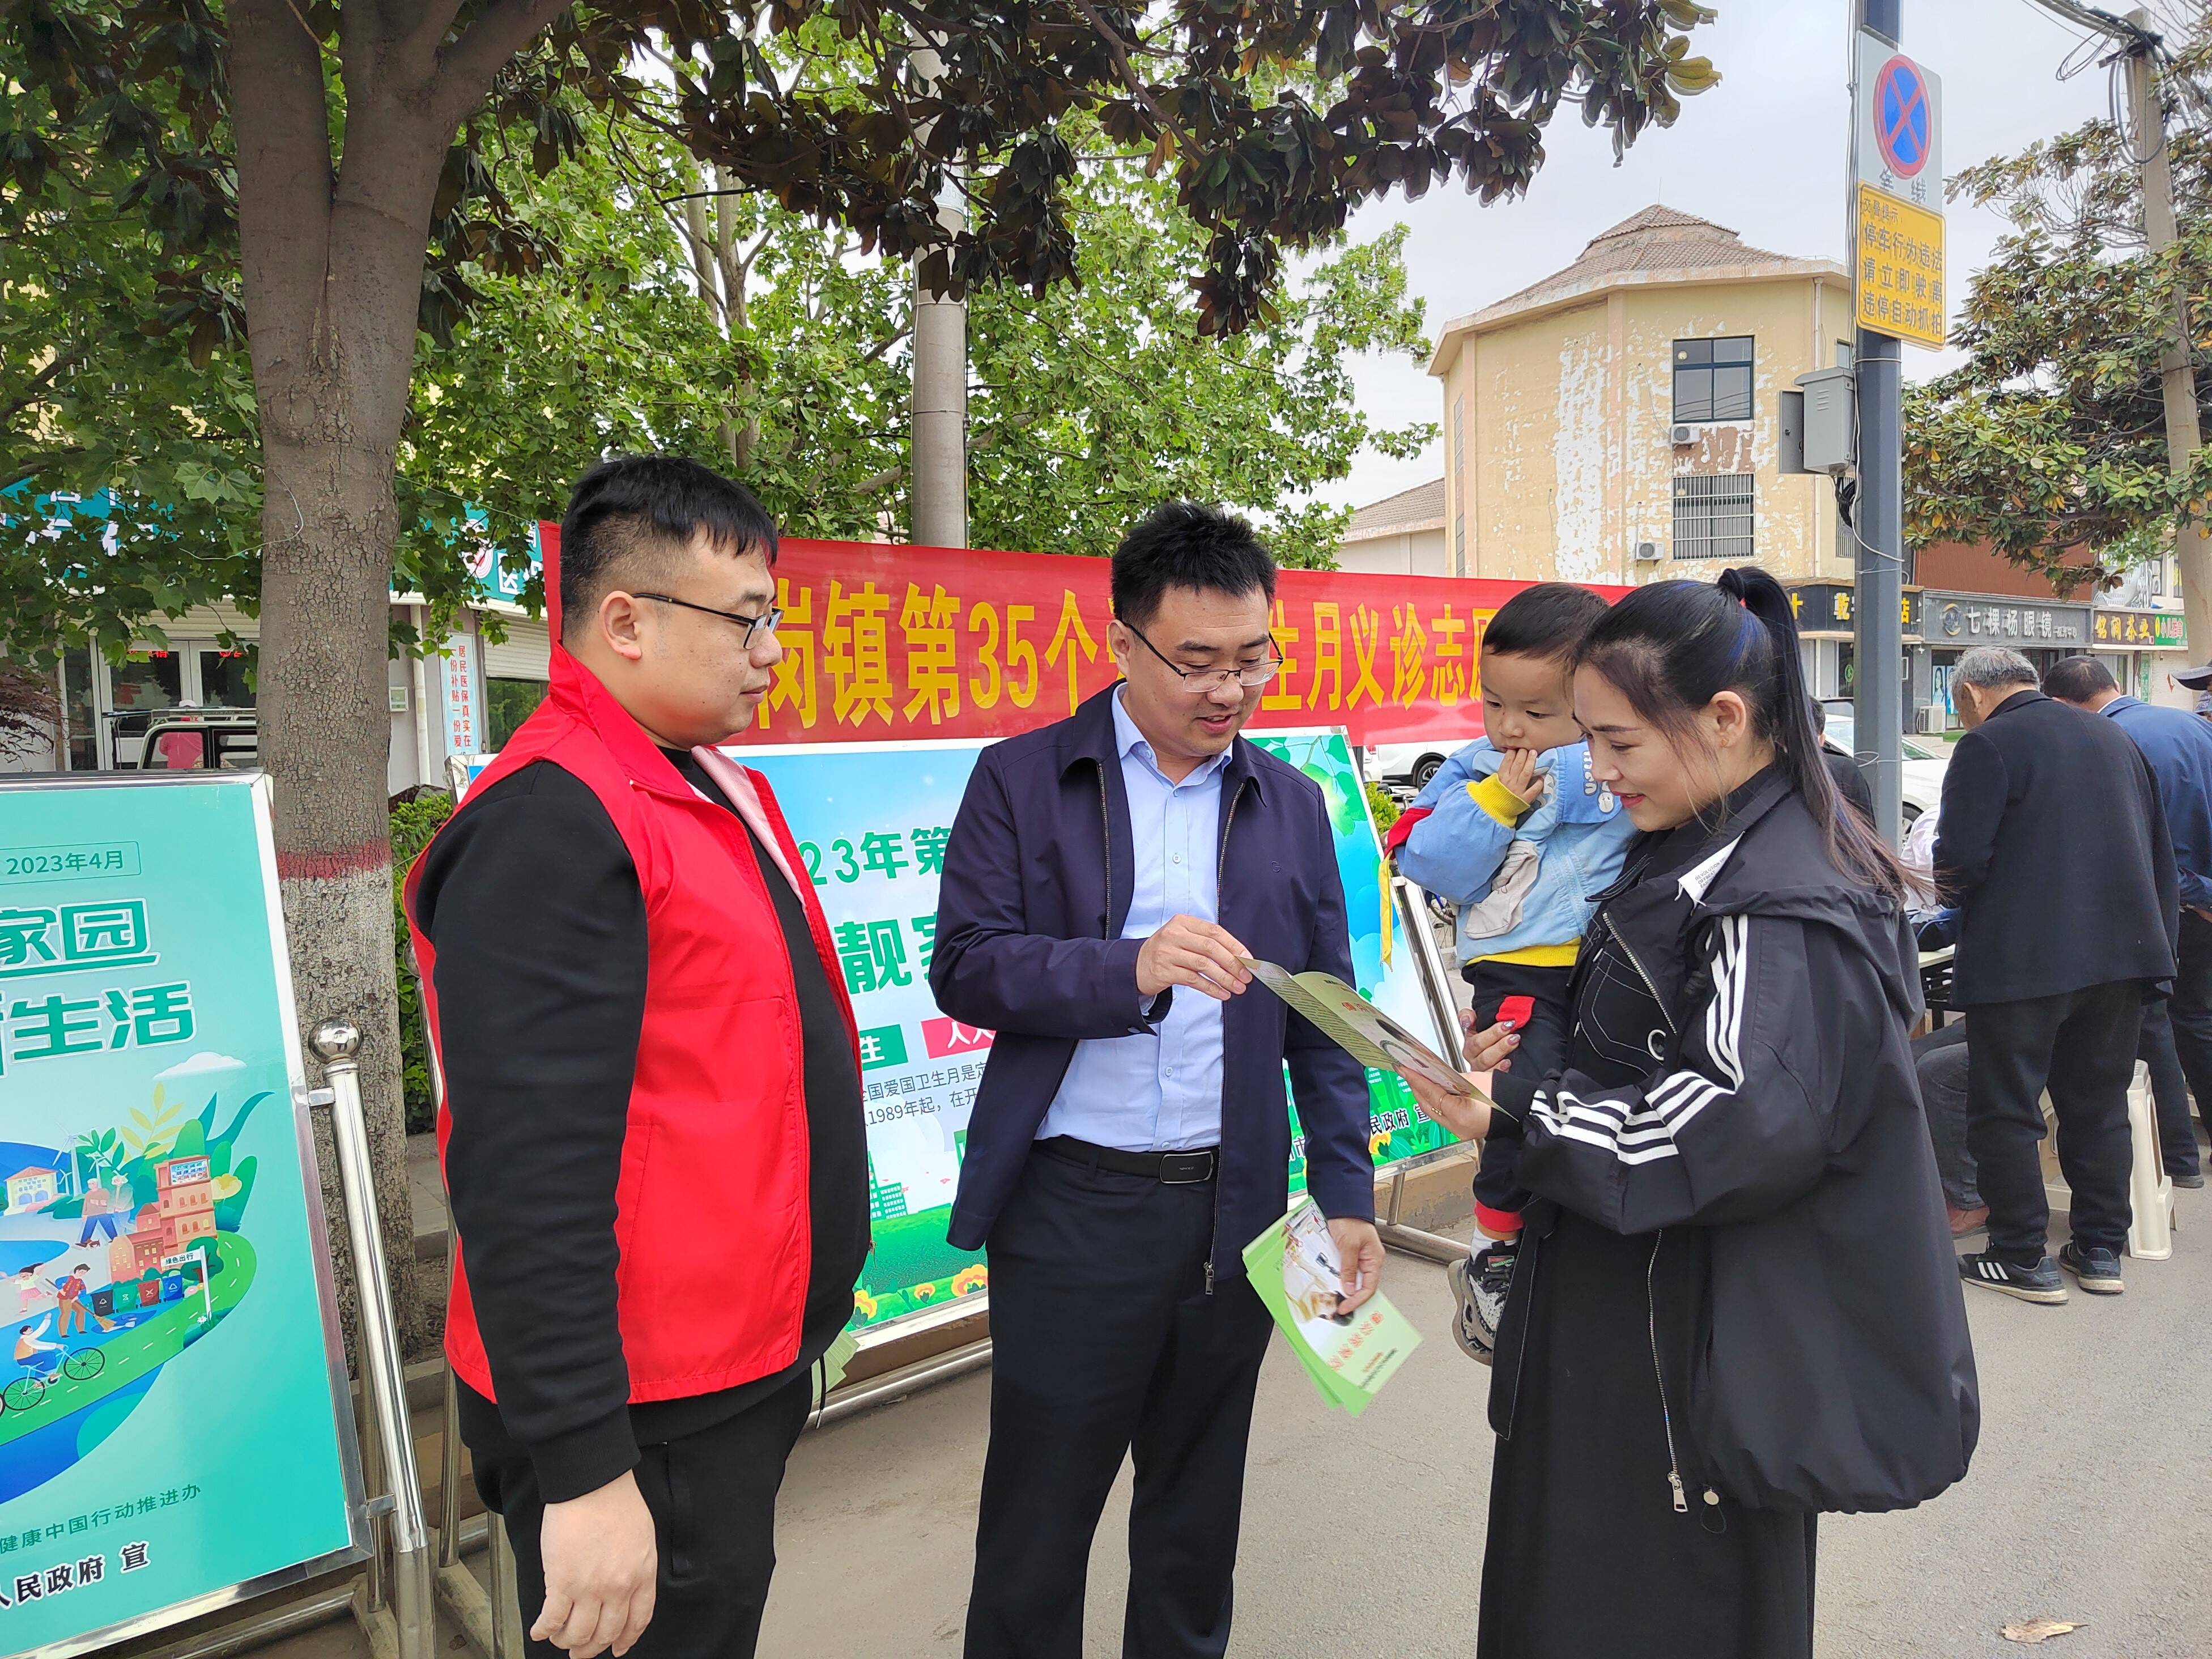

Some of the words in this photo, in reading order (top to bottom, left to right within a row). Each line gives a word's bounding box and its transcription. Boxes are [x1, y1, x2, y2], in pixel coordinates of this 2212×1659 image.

[1864, 221, 1942, 272] 停车行为违法
[1863, 256, 1942, 305] 请立即驶离
[1863, 290, 1942, 335] 违停自动抓拍
[1967, 606, 2052, 638] 七棵杨眼镜
[758, 578, 1125, 729] 岗镇第35个
[450, 648, 462, 747] 一份补贴一份爱
[458, 645, 471, 747] 居民医保真实在
[6, 850, 124, 875] 2023年4月
[0, 900, 148, 964] 家园
[0, 982, 195, 1075] 生活
[866, 1087, 977, 1126] 1989年起，在开
[1290, 1137, 1305, 1160] 市
[1371, 1109, 1409, 1135] 民政府
[165, 1252, 194, 1265] 绿色出行
[0, 1483, 201, 1554] 健康中国行动推进办
[121, 1543, 149, 1571] 宣
